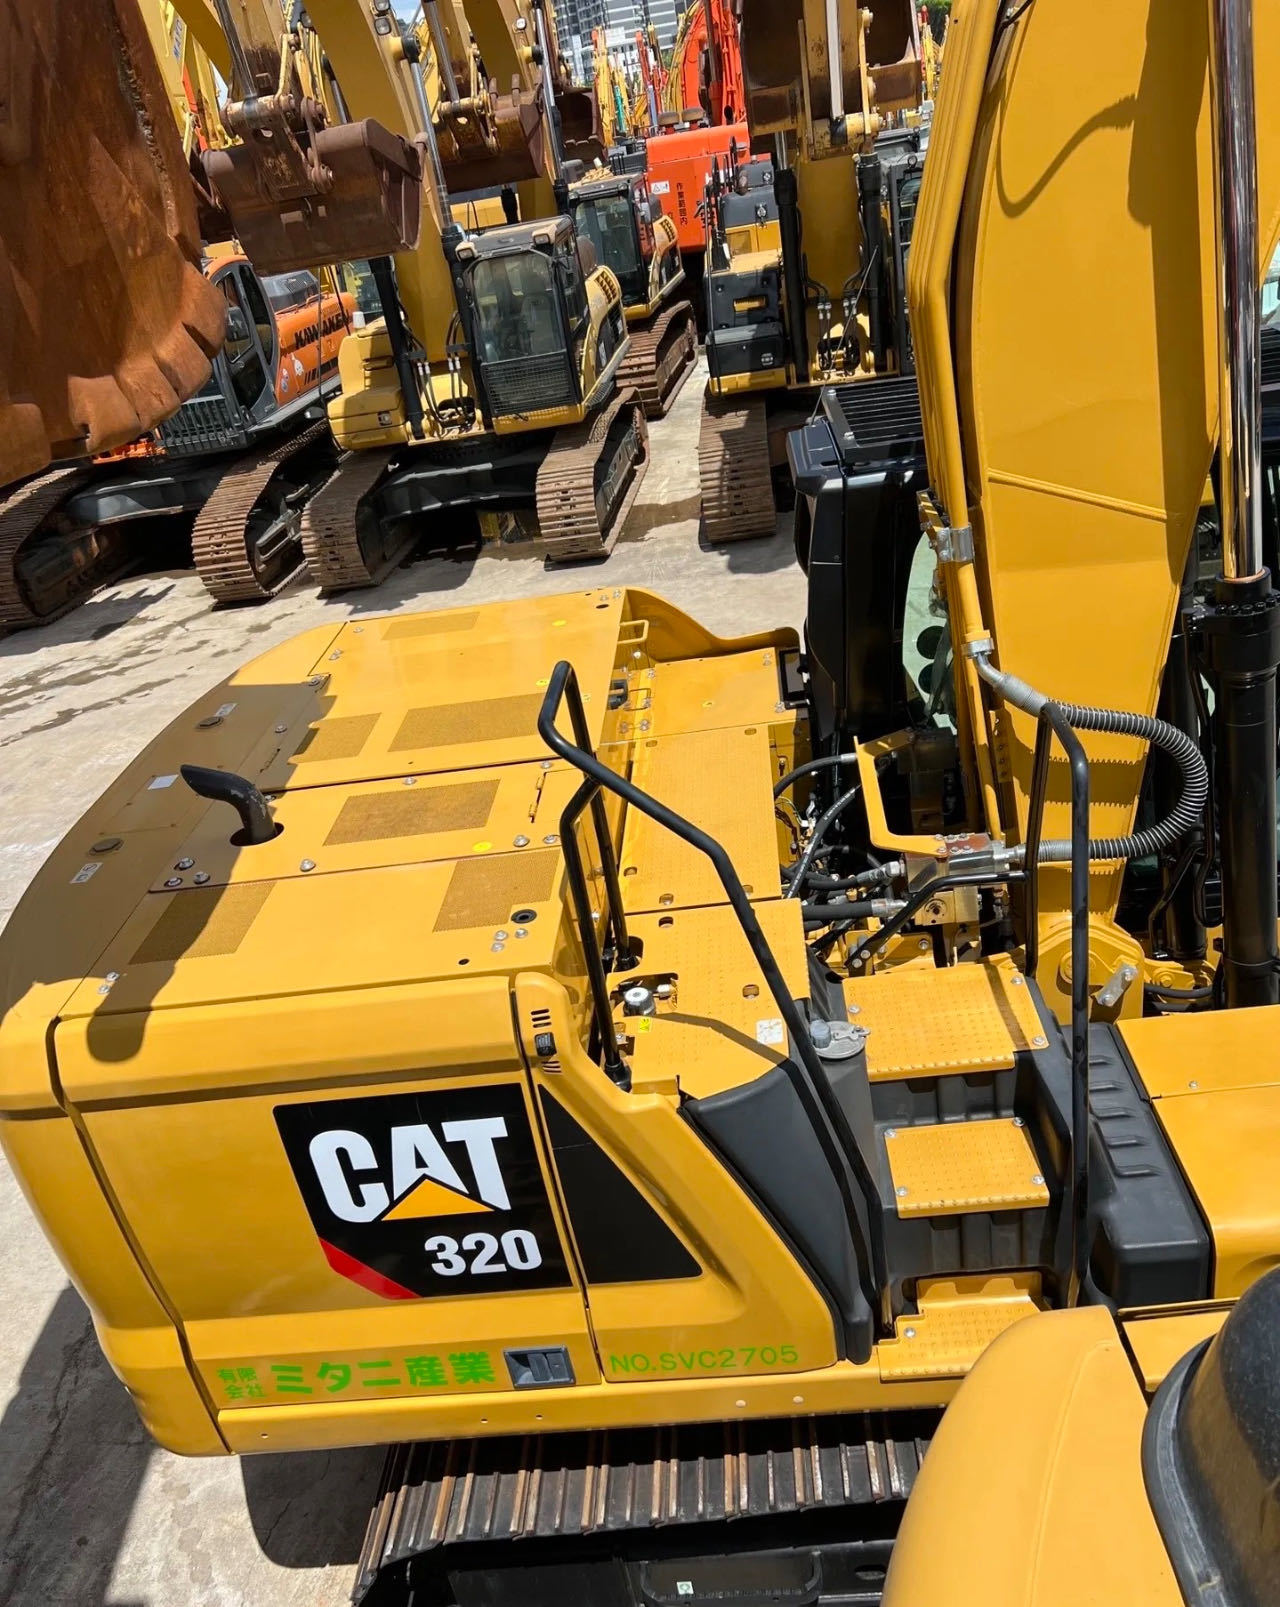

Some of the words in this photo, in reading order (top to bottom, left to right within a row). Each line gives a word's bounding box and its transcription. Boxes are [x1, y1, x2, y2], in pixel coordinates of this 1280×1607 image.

[309, 1117, 511, 1222] CAT
[425, 1230, 542, 1275] 320
[218, 1366, 256, 1382] 有限
[270, 1351, 496, 1394] ミタニ産業
[610, 1345, 799, 1373] NO.SVC2705
[225, 1383, 266, 1400] 会社
